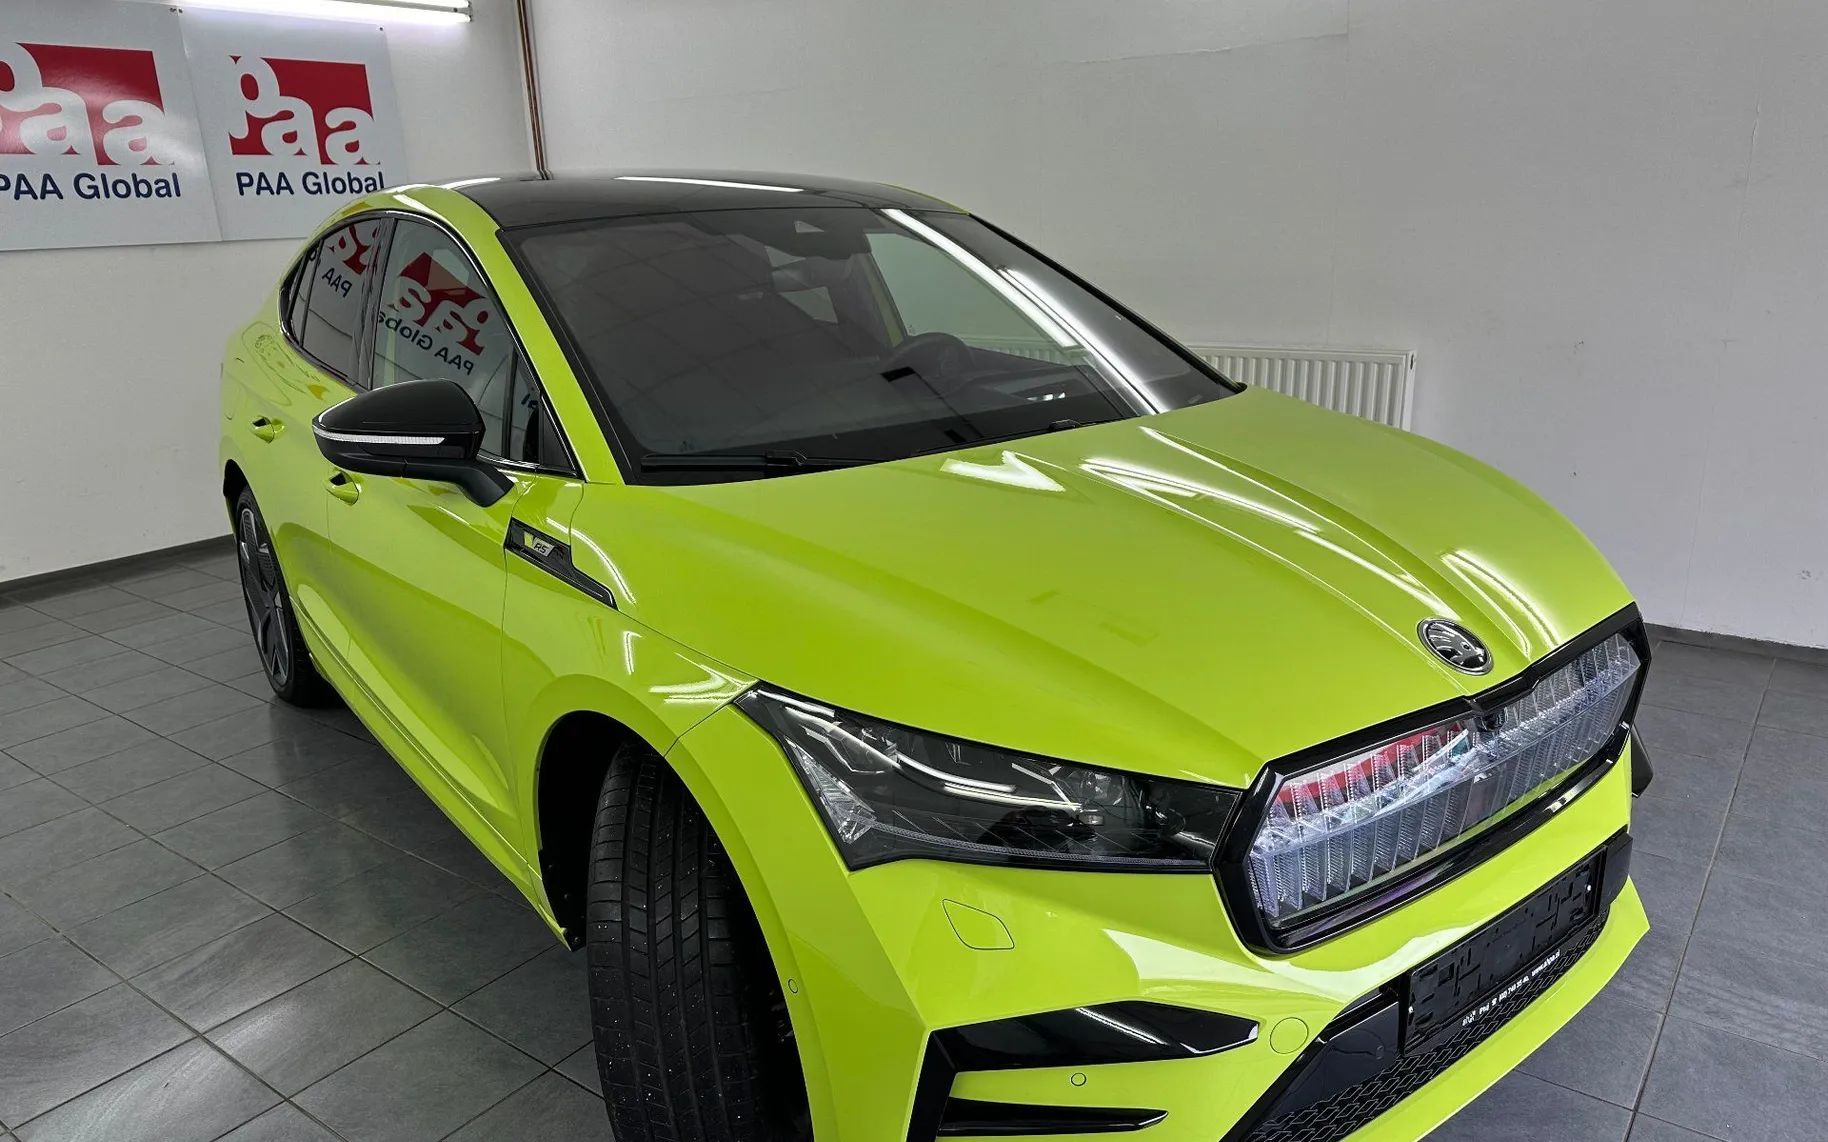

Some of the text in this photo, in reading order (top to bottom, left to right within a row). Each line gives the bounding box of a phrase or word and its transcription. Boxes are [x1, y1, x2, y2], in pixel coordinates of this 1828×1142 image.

[73, 172, 181, 200] Global
[236, 171, 385, 196] PAA Global
[533, 542, 548, 554] RS
